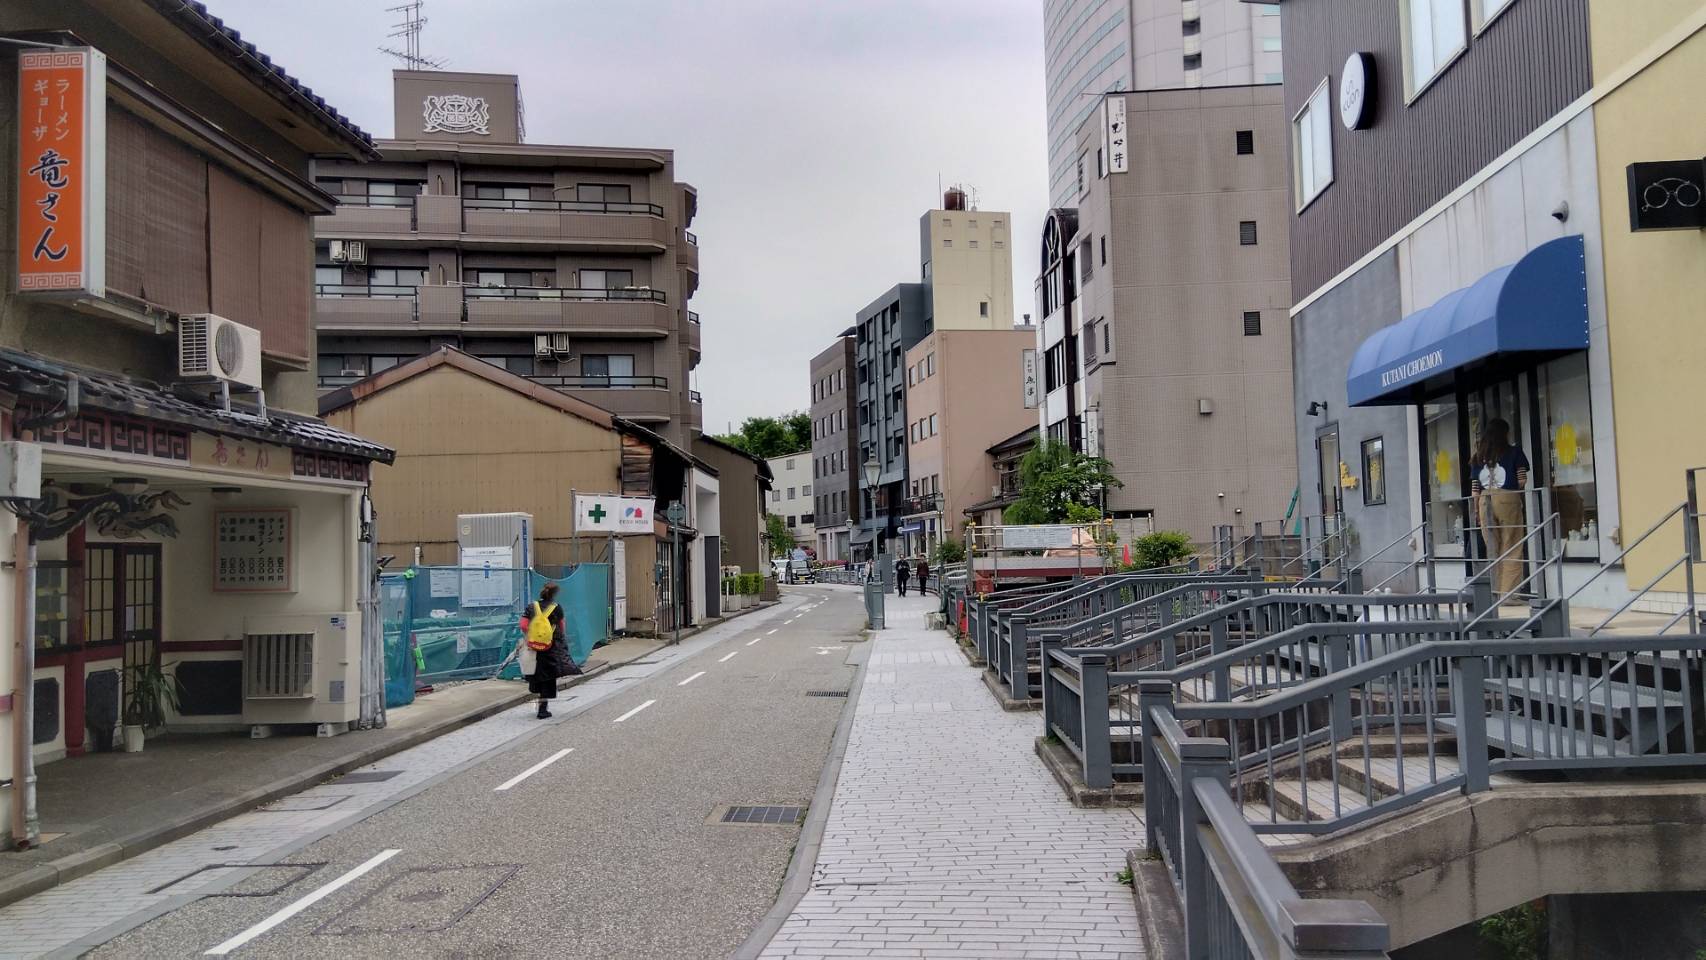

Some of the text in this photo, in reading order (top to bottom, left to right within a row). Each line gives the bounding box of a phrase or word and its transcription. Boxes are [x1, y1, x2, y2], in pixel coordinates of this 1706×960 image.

[32, 79, 49, 142] ギョーザ
[55, 79, 70, 141] ラーメン
[29, 148, 69, 261] 竜さん
[1382, 349, 1443, 387] KUTANI CHOEMON
